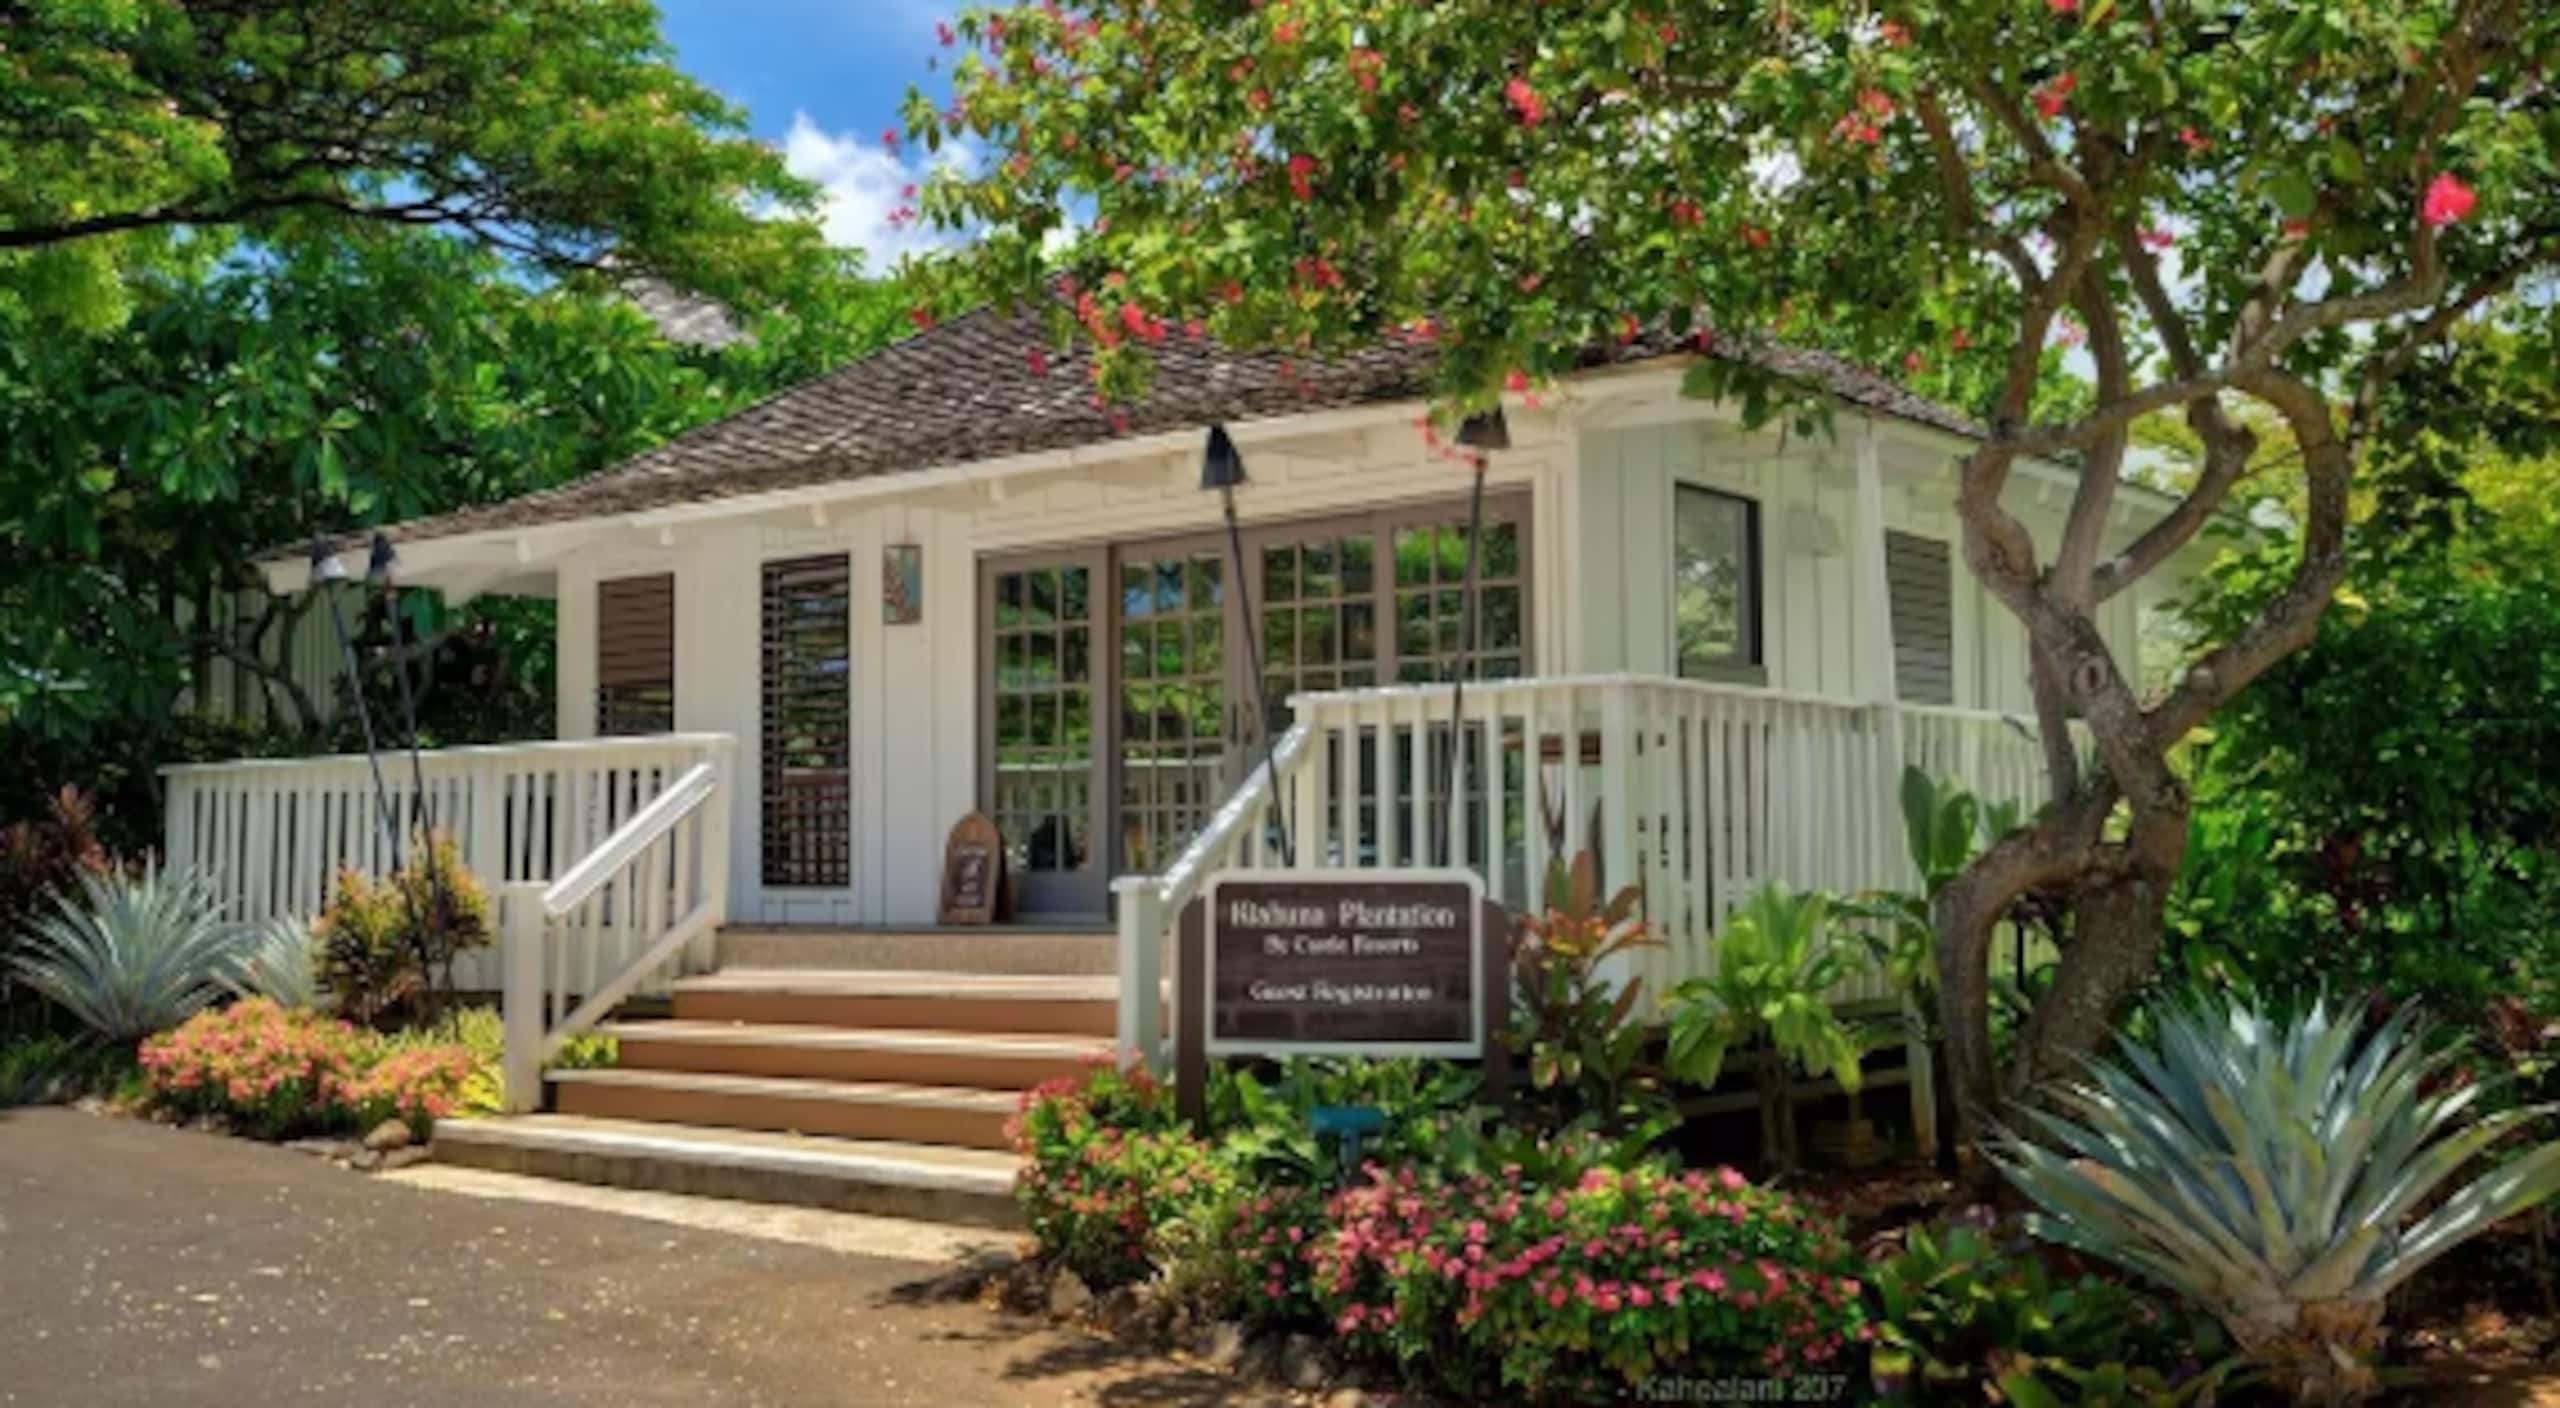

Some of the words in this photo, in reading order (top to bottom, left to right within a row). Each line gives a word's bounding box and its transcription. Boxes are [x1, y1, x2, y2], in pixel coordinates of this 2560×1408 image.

[1339, 900, 1455, 928] Plantation
[1249, 980, 1306, 1002] Guest
[1314, 979, 1433, 1004] Registration
